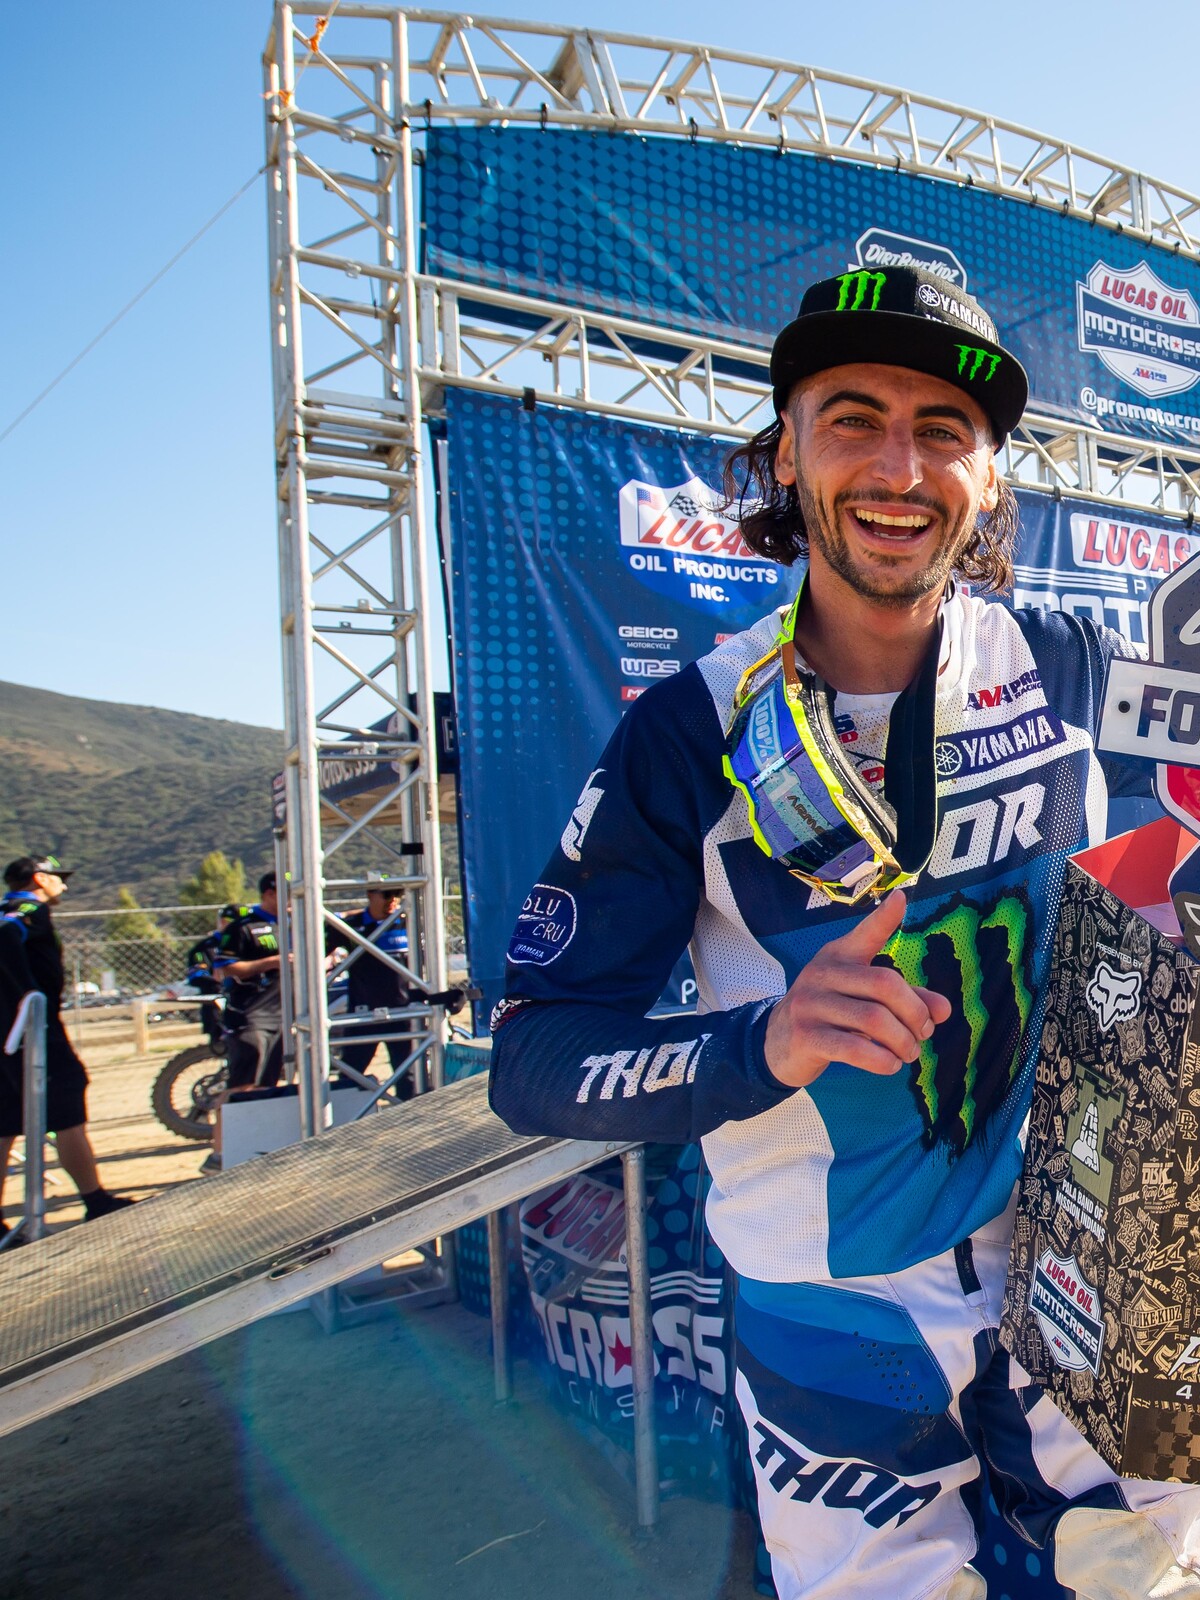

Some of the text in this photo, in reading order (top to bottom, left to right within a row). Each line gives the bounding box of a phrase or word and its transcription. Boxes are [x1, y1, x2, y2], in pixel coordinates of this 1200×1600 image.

[1101, 275, 1187, 320] LUCAS OIL
[940, 293, 996, 344] YAMAHA
[1130, 316, 1163, 331] PRO
[639, 516, 753, 557] LUCA
[1082, 520, 1191, 573] LUCAS
[629, 554, 778, 584] OIL PRODUCTS
[690, 583, 730, 602] INC.
[618, 626, 678, 640] GEICO
[627, 642, 671, 651] MOTORCYCLE
[620, 657, 681, 678] WPS
[961, 715, 1056, 767] YAMAHA
[1095, 941, 1143, 969] PRESENTED BY
[1056, 1190, 1081, 1221] MISSION
[1081, 1211, 1106, 1243] INDIANS
[1062, 1179, 1104, 1221] PALA BAND OF
[1045, 1258, 1094, 1314] LUCAS OIL
[1033, 1293, 1097, 1359] CHAMPIONSHIP
[1034, 1281, 1099, 1350] MOTOCROSS
[1116, 1347, 1149, 1374] dbk.
